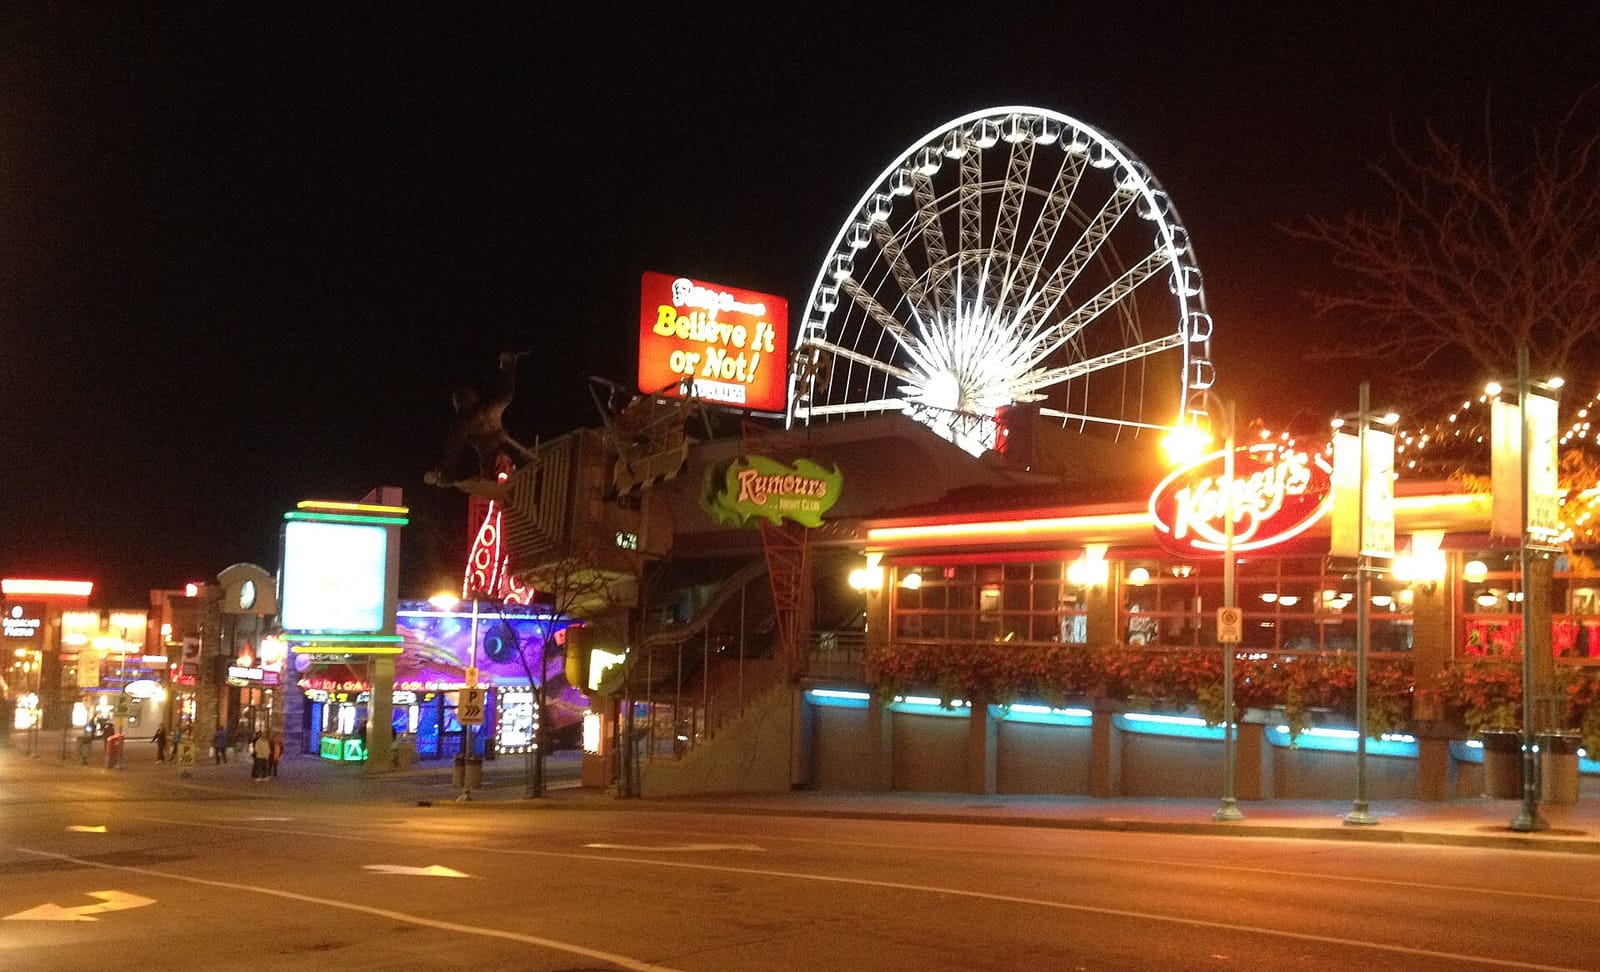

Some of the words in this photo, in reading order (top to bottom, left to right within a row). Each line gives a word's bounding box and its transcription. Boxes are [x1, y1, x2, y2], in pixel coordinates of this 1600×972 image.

[653, 305, 747, 348] Believe
[751, 321, 776, 353] It
[669, 350, 700, 375] or
[702, 346, 760, 384] Not!
[738, 468, 827, 505] Rumours
[469, 690, 478, 703] P
